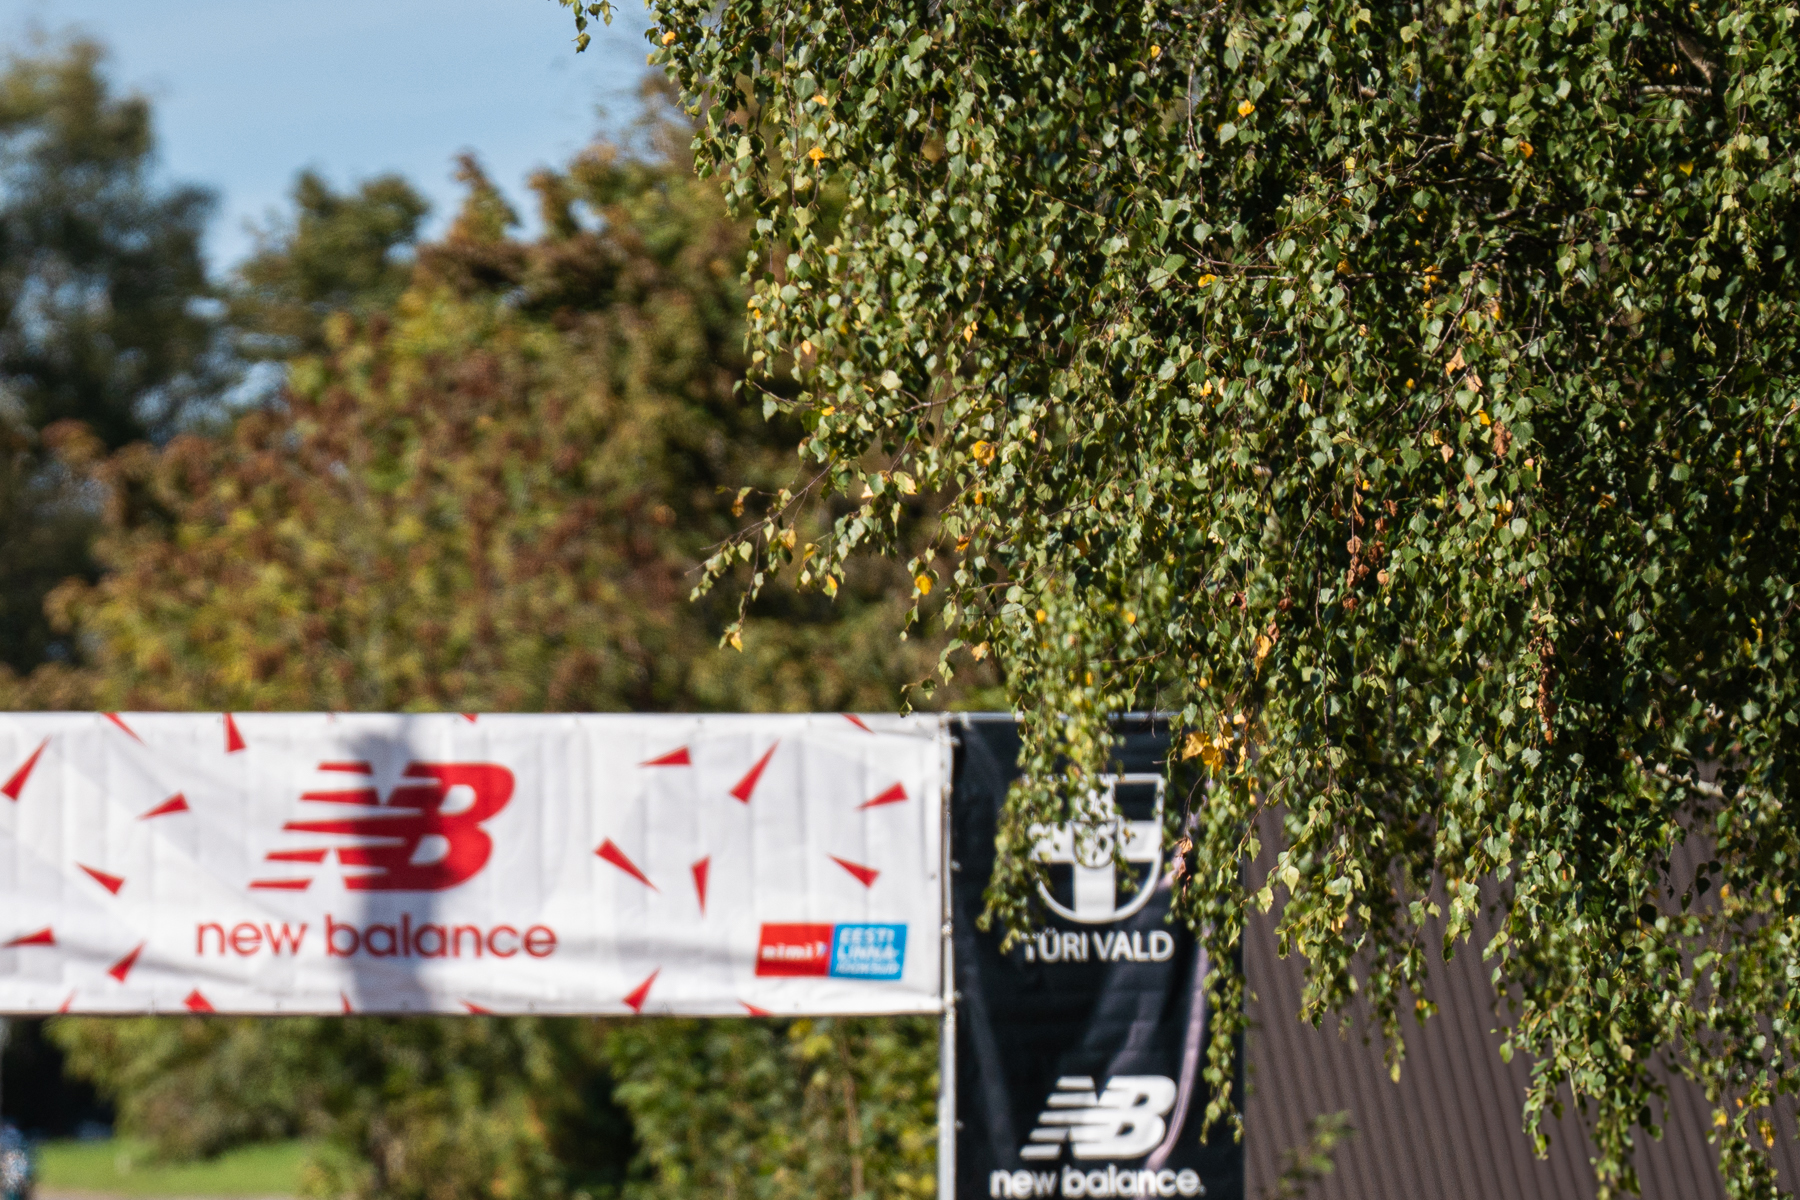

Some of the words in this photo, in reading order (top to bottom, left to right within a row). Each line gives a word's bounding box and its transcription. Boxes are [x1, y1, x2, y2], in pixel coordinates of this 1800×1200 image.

[195, 922, 307, 957] new
[326, 914, 558, 959] balance
[1093, 930, 1174, 962] VALD
[989, 1169, 1057, 1198] new
[1061, 1163, 1203, 1198] balance
